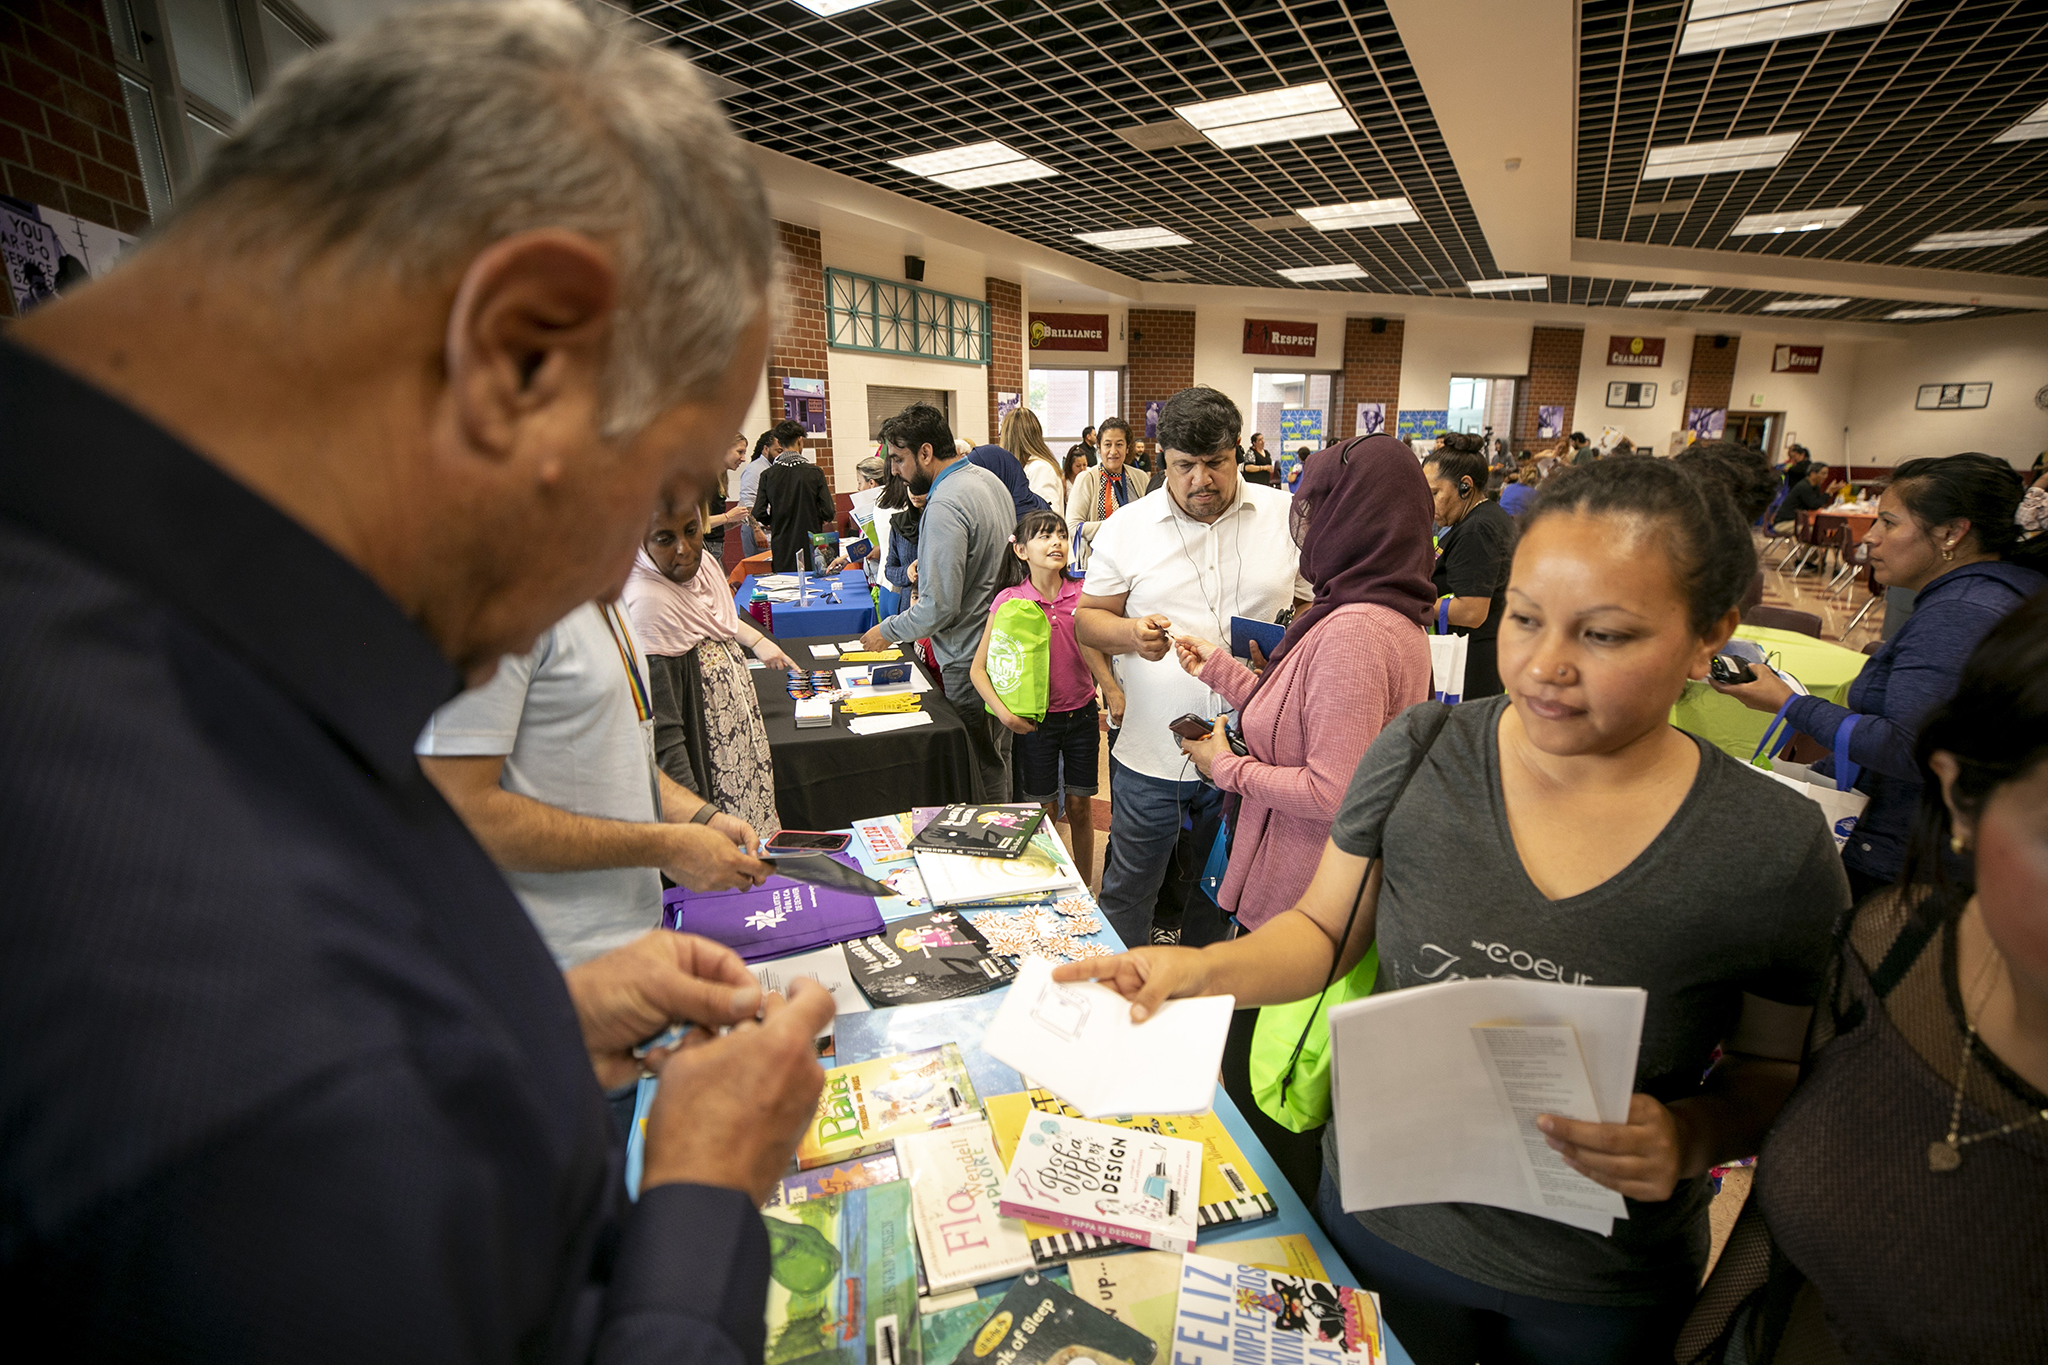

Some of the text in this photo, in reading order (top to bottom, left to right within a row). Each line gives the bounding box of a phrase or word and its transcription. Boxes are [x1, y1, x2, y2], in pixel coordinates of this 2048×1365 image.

[9, 215, 43, 242] YOU
[1043, 325, 1103, 339] BRILLIANCE
[1271, 331, 1315, 346] RESPECT
[1611, 352, 1659, 365] CHARACTER
[951, 1138, 986, 1200] Wendell
[1101, 1136, 1128, 1195] DESIGN
[968, 1147, 1008, 1219] XPLORE
[1071, 1218, 1096, 1232] PIPPA
[1108, 1227, 1143, 1242] DESIGN
[1011, 1328, 1028, 1351] of
